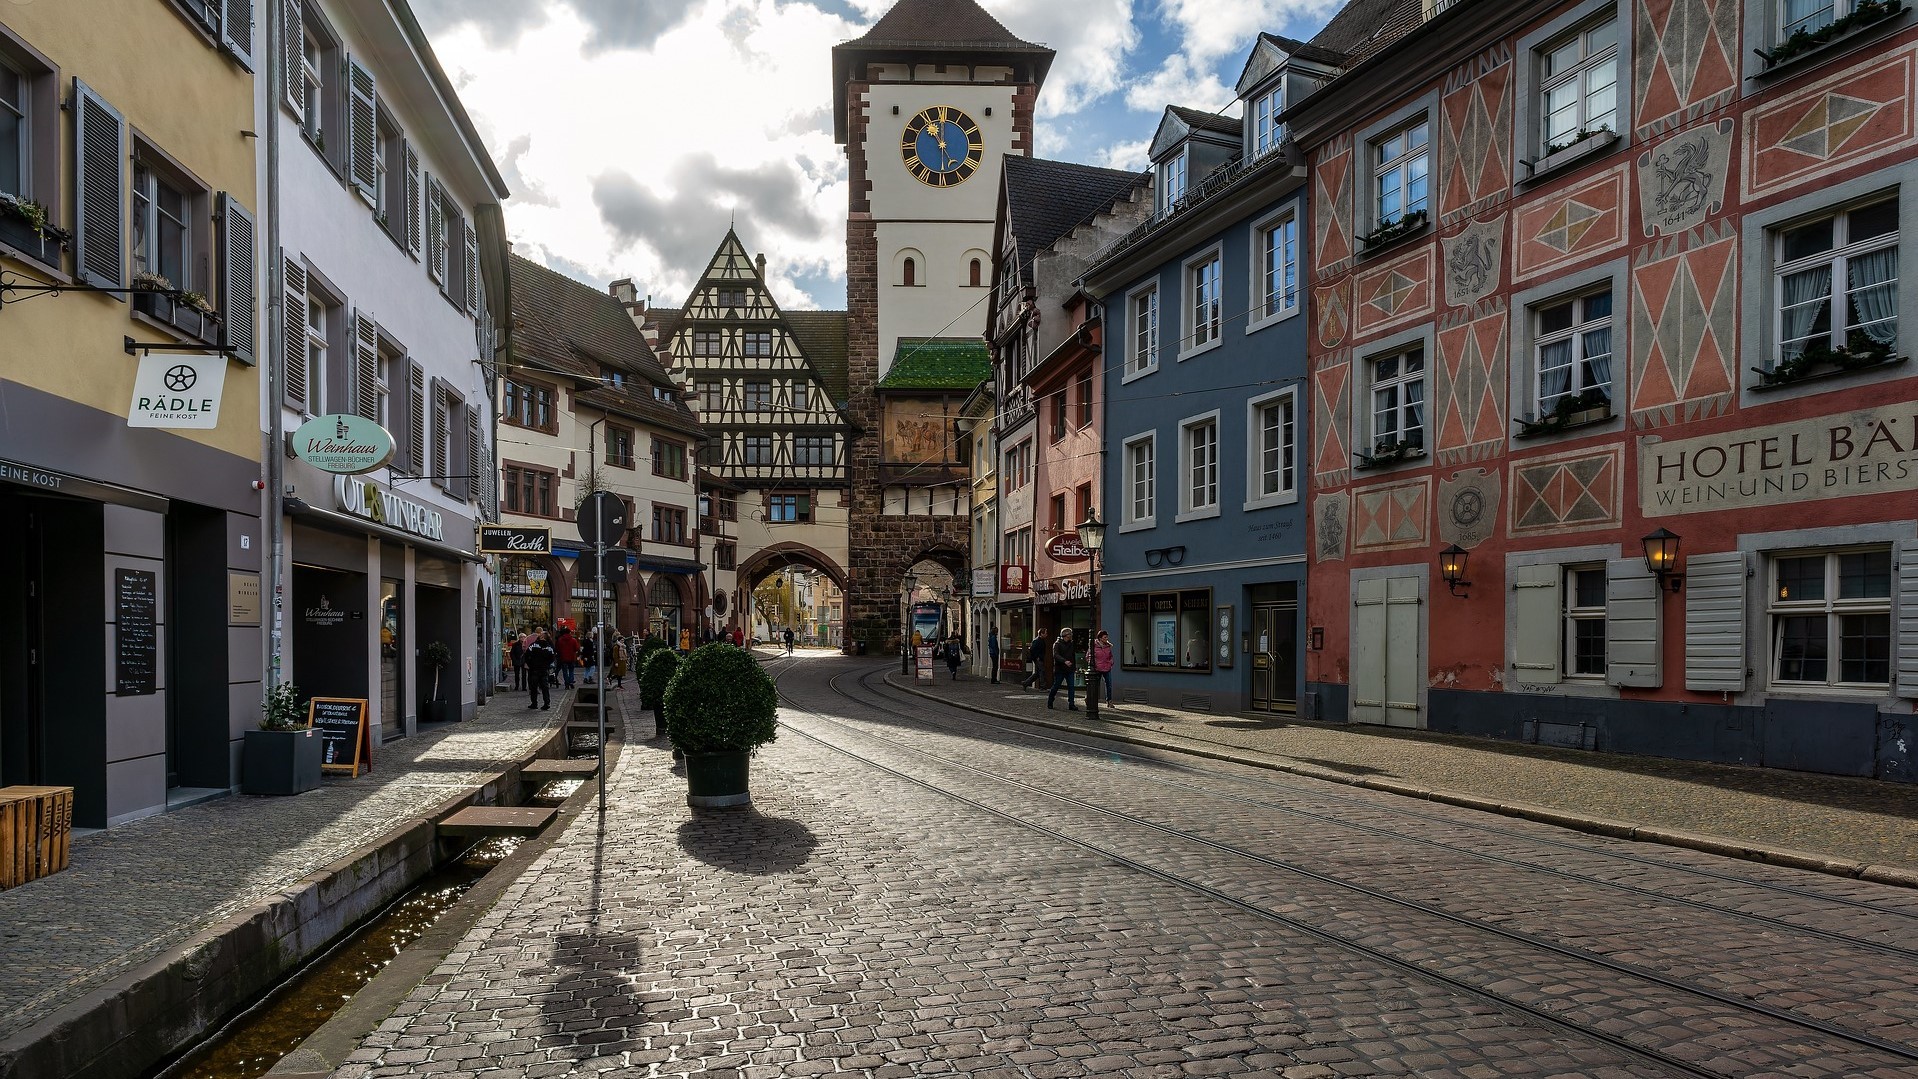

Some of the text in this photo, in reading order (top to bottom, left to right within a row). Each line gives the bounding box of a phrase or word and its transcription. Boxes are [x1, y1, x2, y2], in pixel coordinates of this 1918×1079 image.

[1663, 210, 1685, 227] 1641
[138, 394, 213, 412] RÄDLE
[149, 412, 174, 420] FEINE
[307, 437, 379, 455] Weinhaus
[1655, 414, 1918, 485] HOTEL BÄ
[308, 455, 375, 464] STELLWAGEN-BÜCHNER
[327, 462, 356, 470] FREIBURG
[0, 465, 61, 488] EINE KOST
[379, 490, 444, 541] VINEGAR
[507, 534, 545, 551] Rath
[1459, 531, 1477, 541] 1685
[1053, 545, 1090, 556] Steibe
[1154, 600, 1173, 610] OPTIK
[43, 806, 52, 841] Wein
[54, 804, 62, 838] Wein
